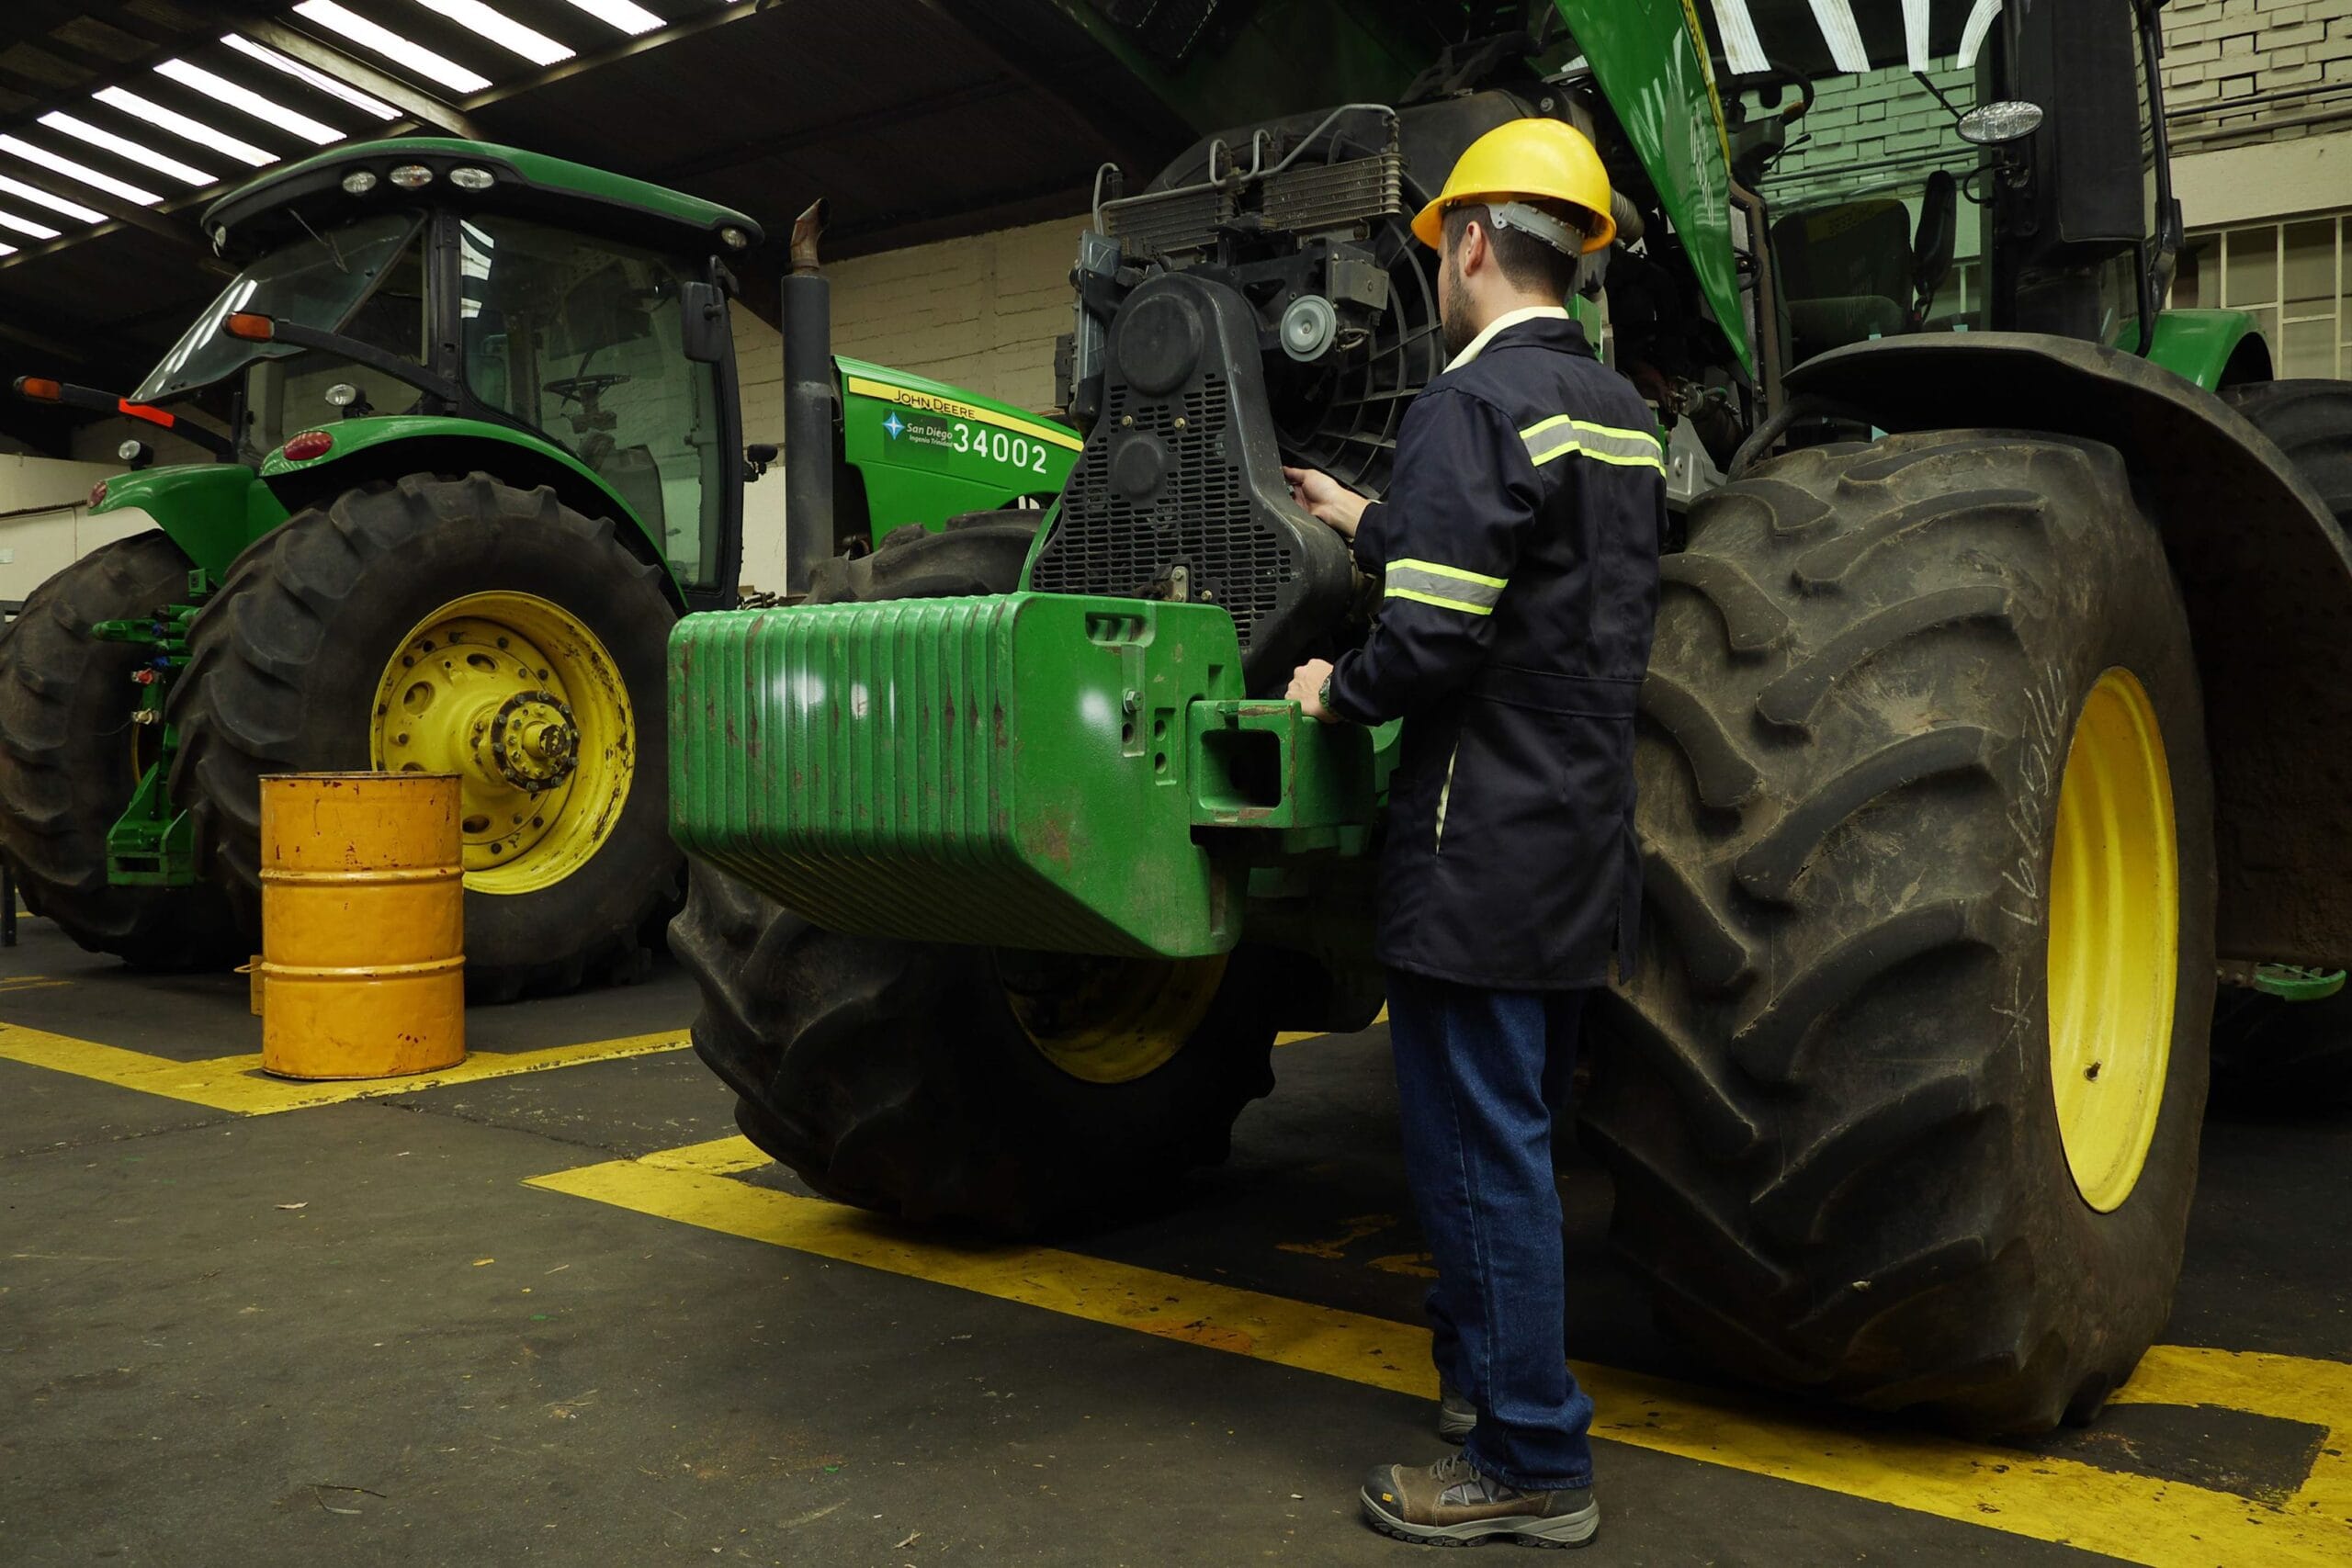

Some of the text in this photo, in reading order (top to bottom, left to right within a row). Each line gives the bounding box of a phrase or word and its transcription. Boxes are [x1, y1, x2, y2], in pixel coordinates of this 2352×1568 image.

[894, 389, 976, 419] JOHN DEERE
[907, 423, 953, 440] San Diego
[954, 423, 1046, 474] 34002
